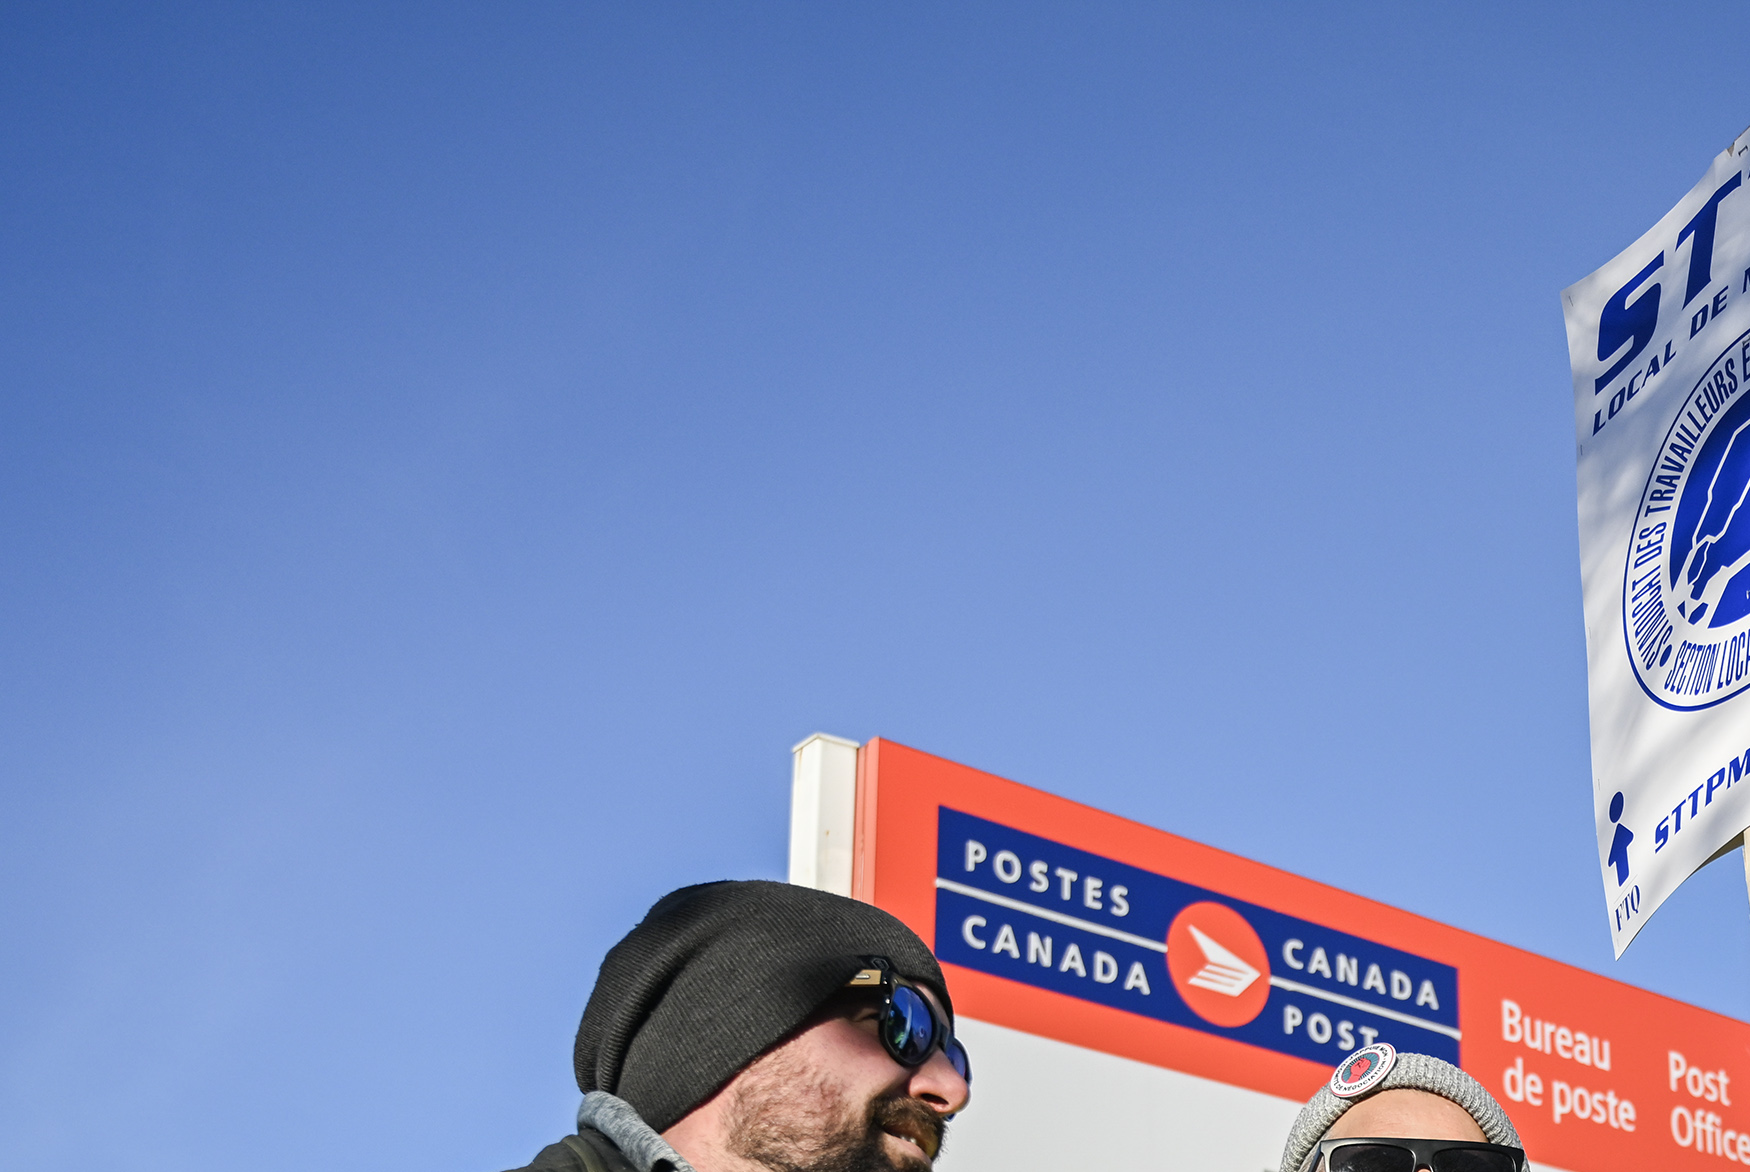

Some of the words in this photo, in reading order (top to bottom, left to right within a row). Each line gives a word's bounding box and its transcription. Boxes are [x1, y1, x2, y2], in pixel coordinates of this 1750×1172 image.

[1592, 340, 1677, 437] LOCAL
[1688, 286, 1729, 341] DE
[1644, 356, 1739, 518] TRAVAILLEURS
[1633, 520, 1667, 570] DES
[1631, 578, 1674, 671] SYNDICAT
[1663, 639, 1718, 696] SECTION
[964, 839, 1130, 917] POSTES
[1615, 884, 1641, 933] FTQ
[962, 915, 1151, 995] CANADA
[1282, 938, 1440, 1010] CANADA
[1283, 1004, 1379, 1051] POST
[1501, 999, 1611, 1072] Bureau
[1503, 1056, 1544, 1107] de
[1551, 1079, 1637, 1132] poste
[1667, 1049, 1732, 1106] Post
